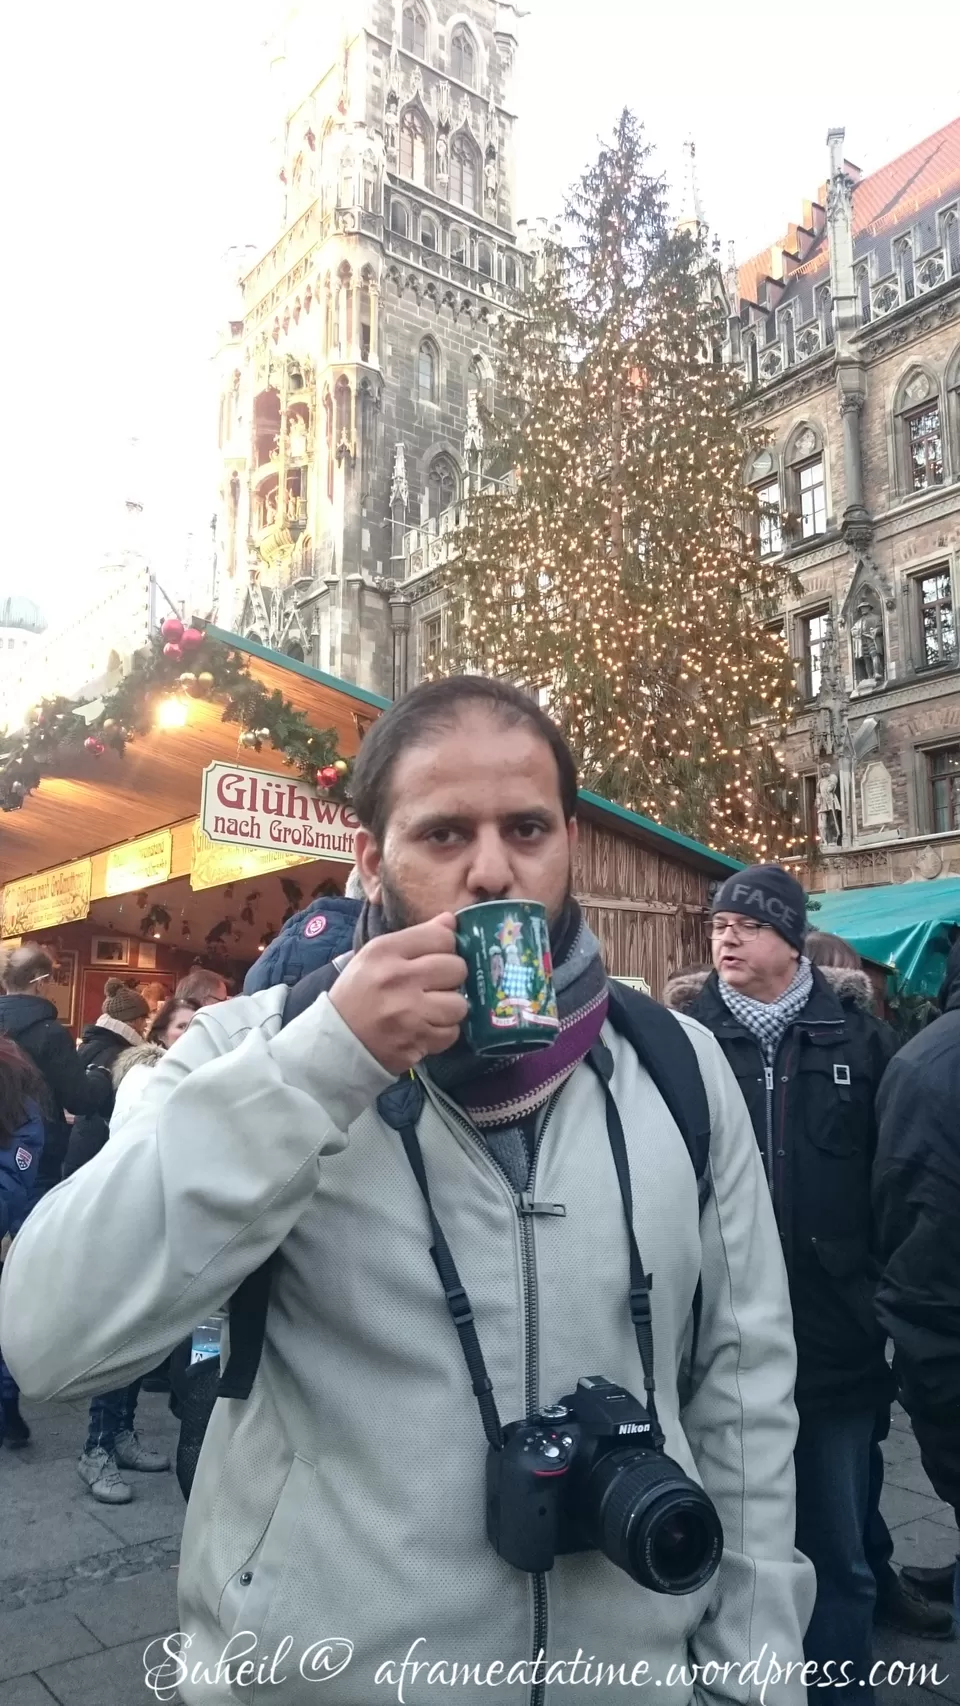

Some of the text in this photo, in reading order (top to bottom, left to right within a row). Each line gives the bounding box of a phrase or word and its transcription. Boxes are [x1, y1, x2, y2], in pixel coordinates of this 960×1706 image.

[217, 774, 361, 829] Glühwe
[213, 815, 261, 840] nach
[269, 819, 355, 853] Großmutt
[731, 883, 799, 929] FACE
[618, 1423, 651, 1435] Nikon
